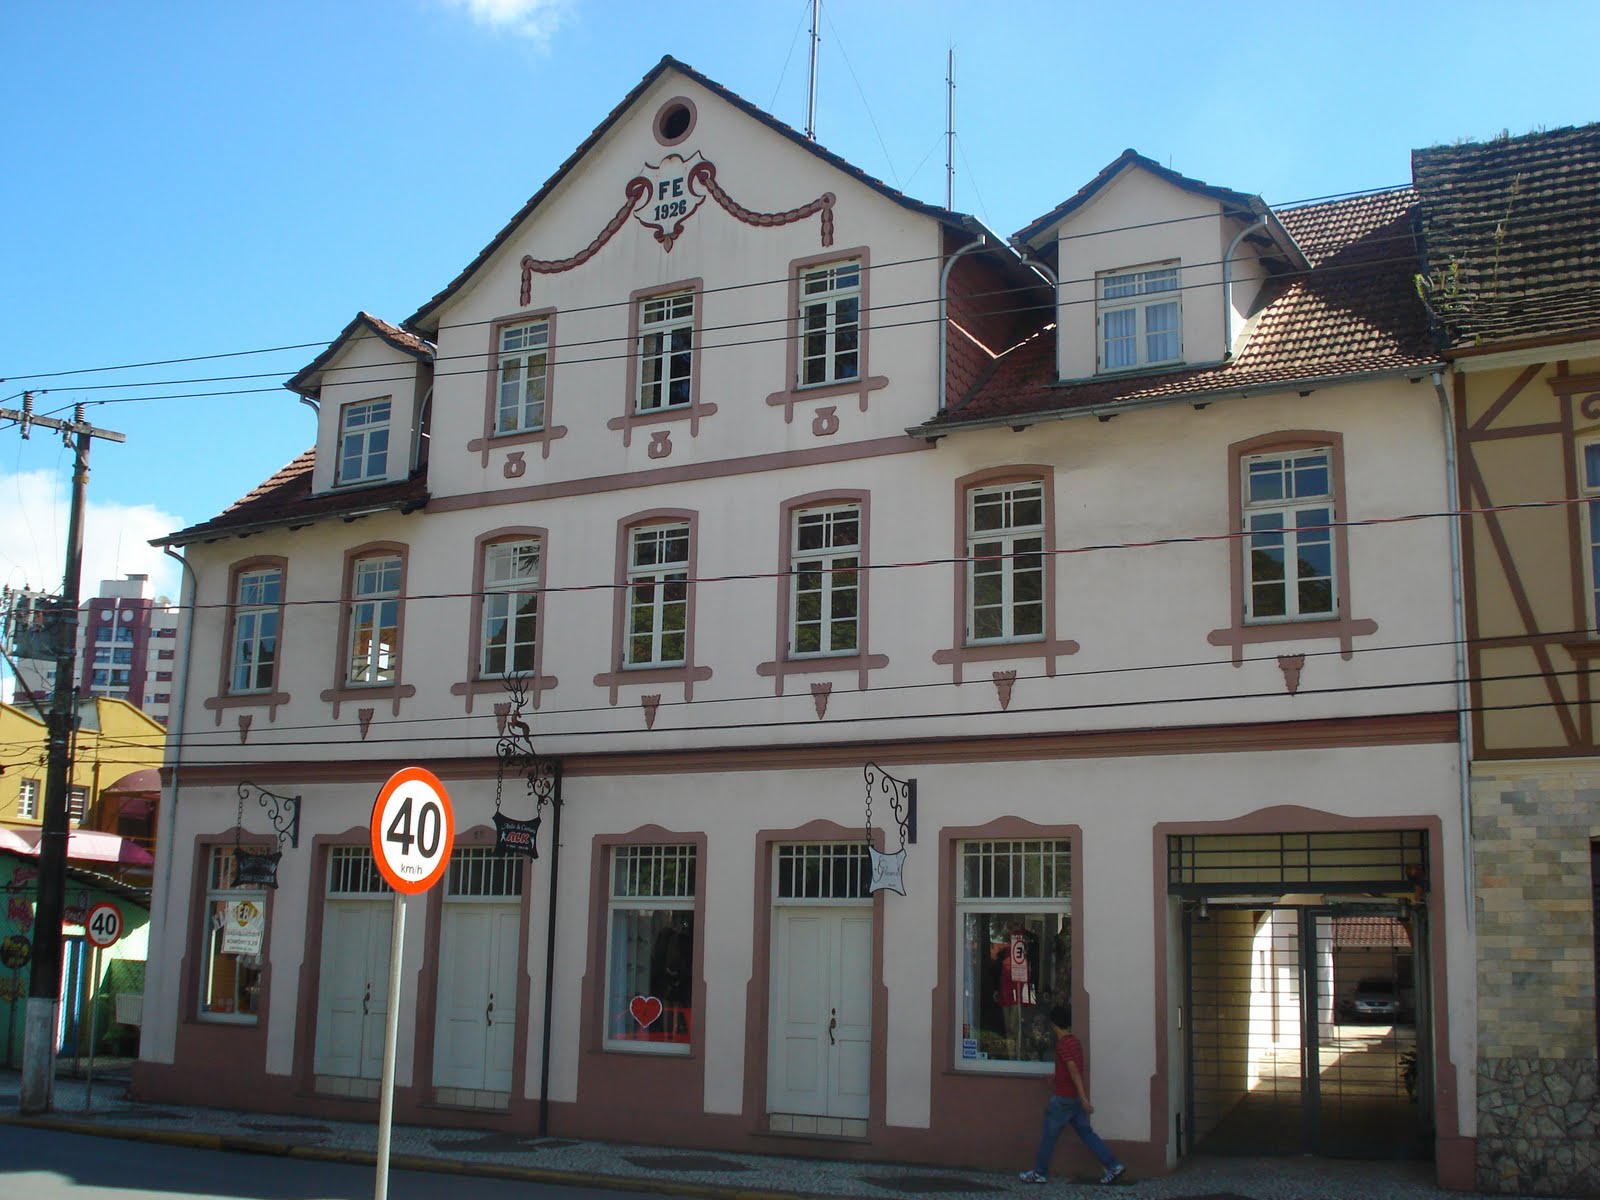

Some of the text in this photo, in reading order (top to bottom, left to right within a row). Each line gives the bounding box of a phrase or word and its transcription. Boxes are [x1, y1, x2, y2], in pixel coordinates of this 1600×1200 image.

[659, 177, 684, 200] FE
[654, 199, 687, 221] 1926
[386, 797, 441, 859] 40
[401, 863, 423, 875] km/h
[92, 912, 117, 935] 40
